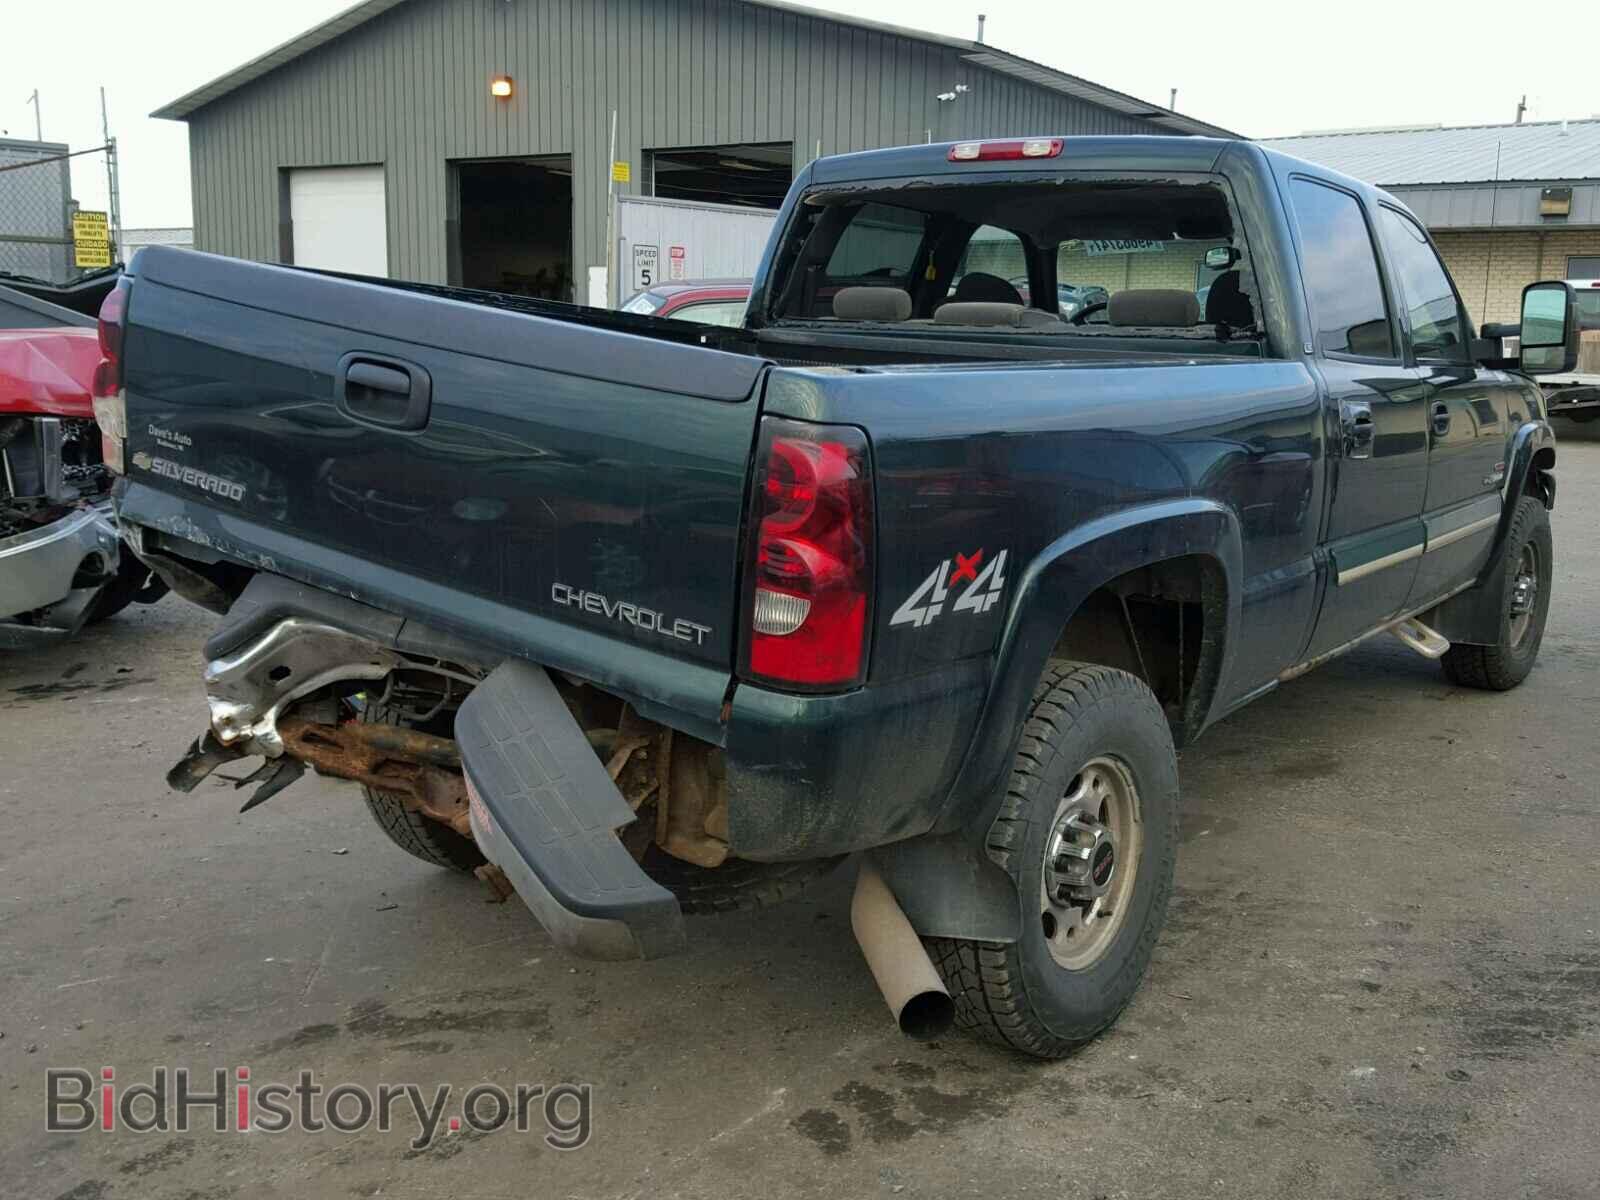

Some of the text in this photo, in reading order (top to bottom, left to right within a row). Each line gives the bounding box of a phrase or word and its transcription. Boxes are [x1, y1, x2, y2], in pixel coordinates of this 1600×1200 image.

[73, 212, 106, 221] CAUTION
[635, 249, 656, 257] SPEED
[637, 259, 654, 267] LIMIT
[641, 269, 651, 286] 5
[148, 424, 172, 441] Dave's
[174, 431, 192, 446] Auto
[151, 457, 246, 501] SILVERADO
[551, 582, 712, 645] CHEVROLET
